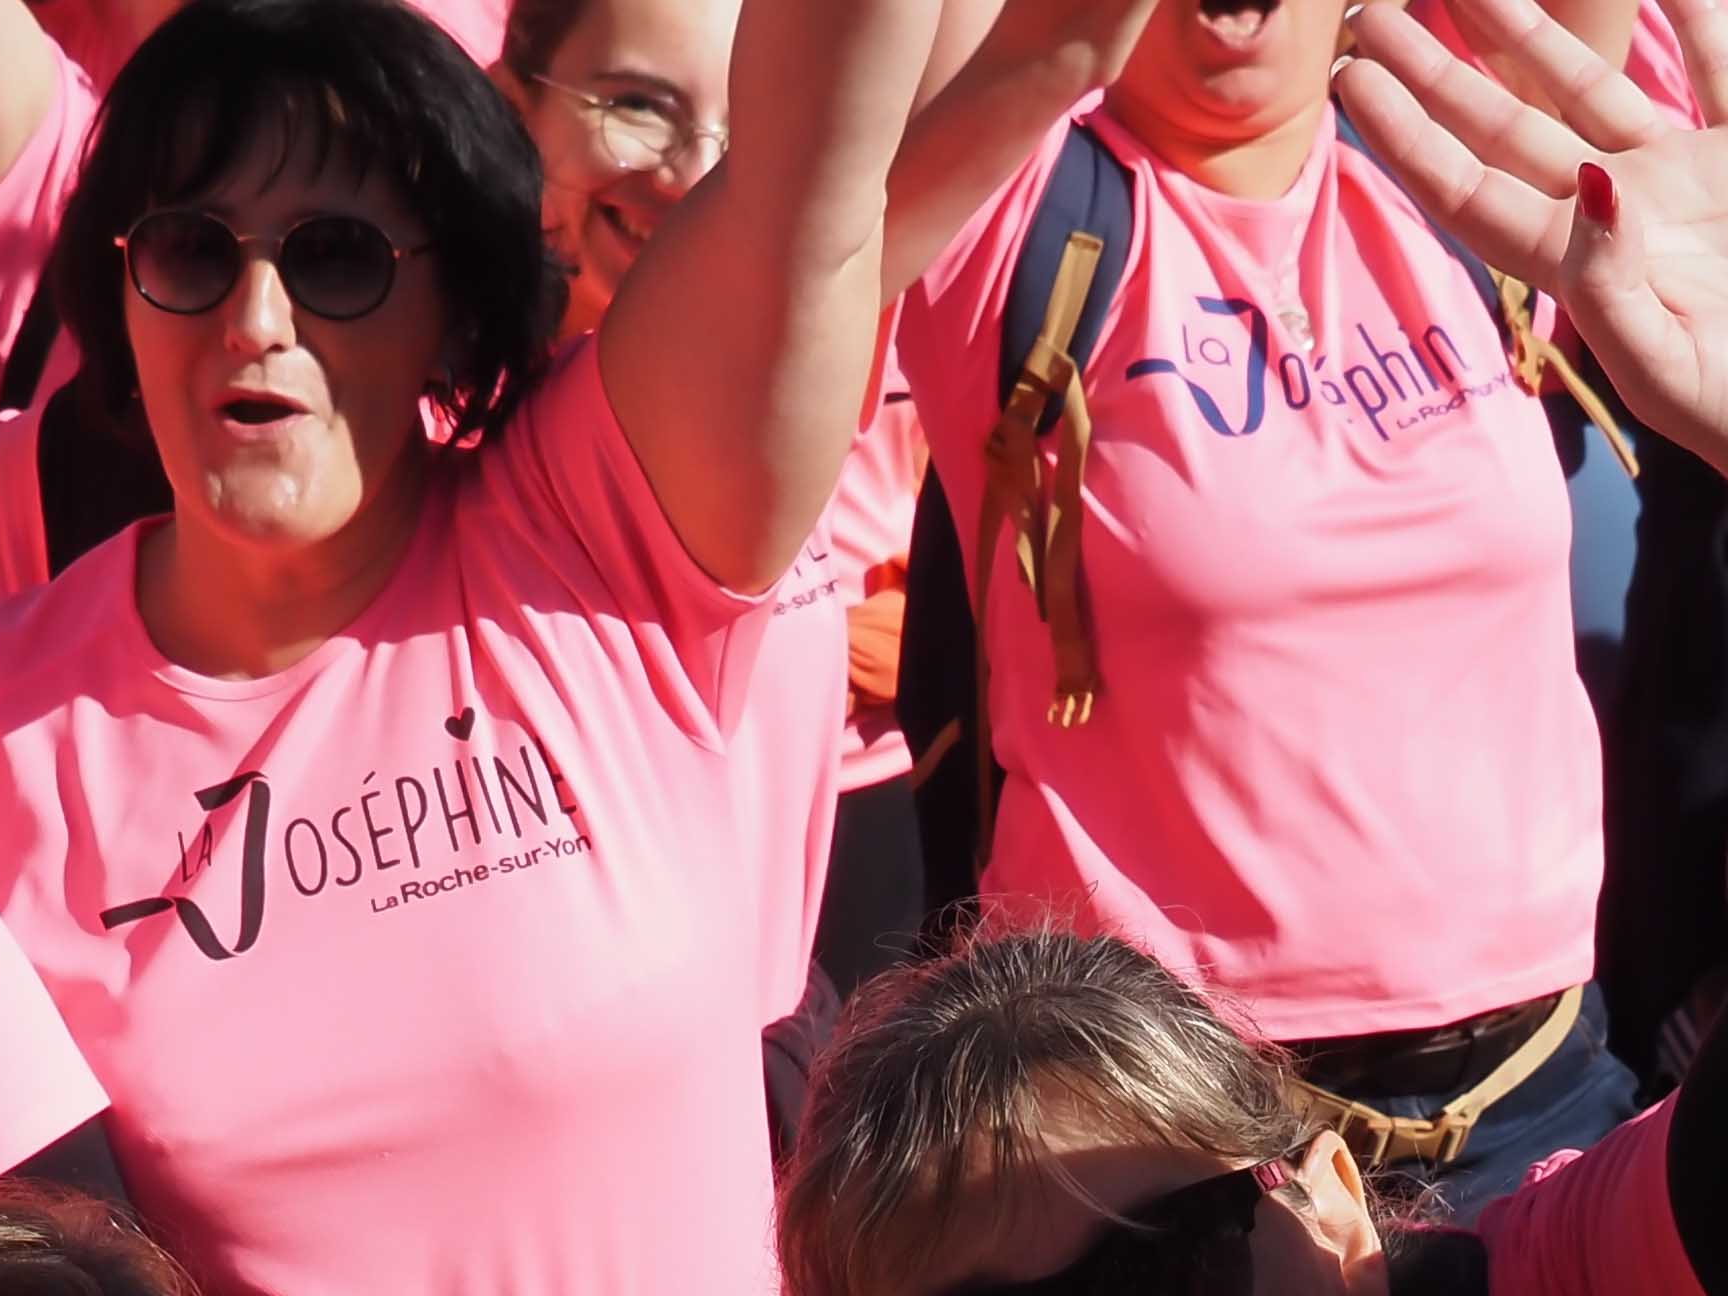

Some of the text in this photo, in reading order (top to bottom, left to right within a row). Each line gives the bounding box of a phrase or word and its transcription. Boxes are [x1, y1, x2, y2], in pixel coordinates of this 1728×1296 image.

[1182, 323, 1233, 369] la
[100, 738, 578, 961] LA JOSÉPHINE
[371, 833, 592, 913] La Roche-sur-Yon
